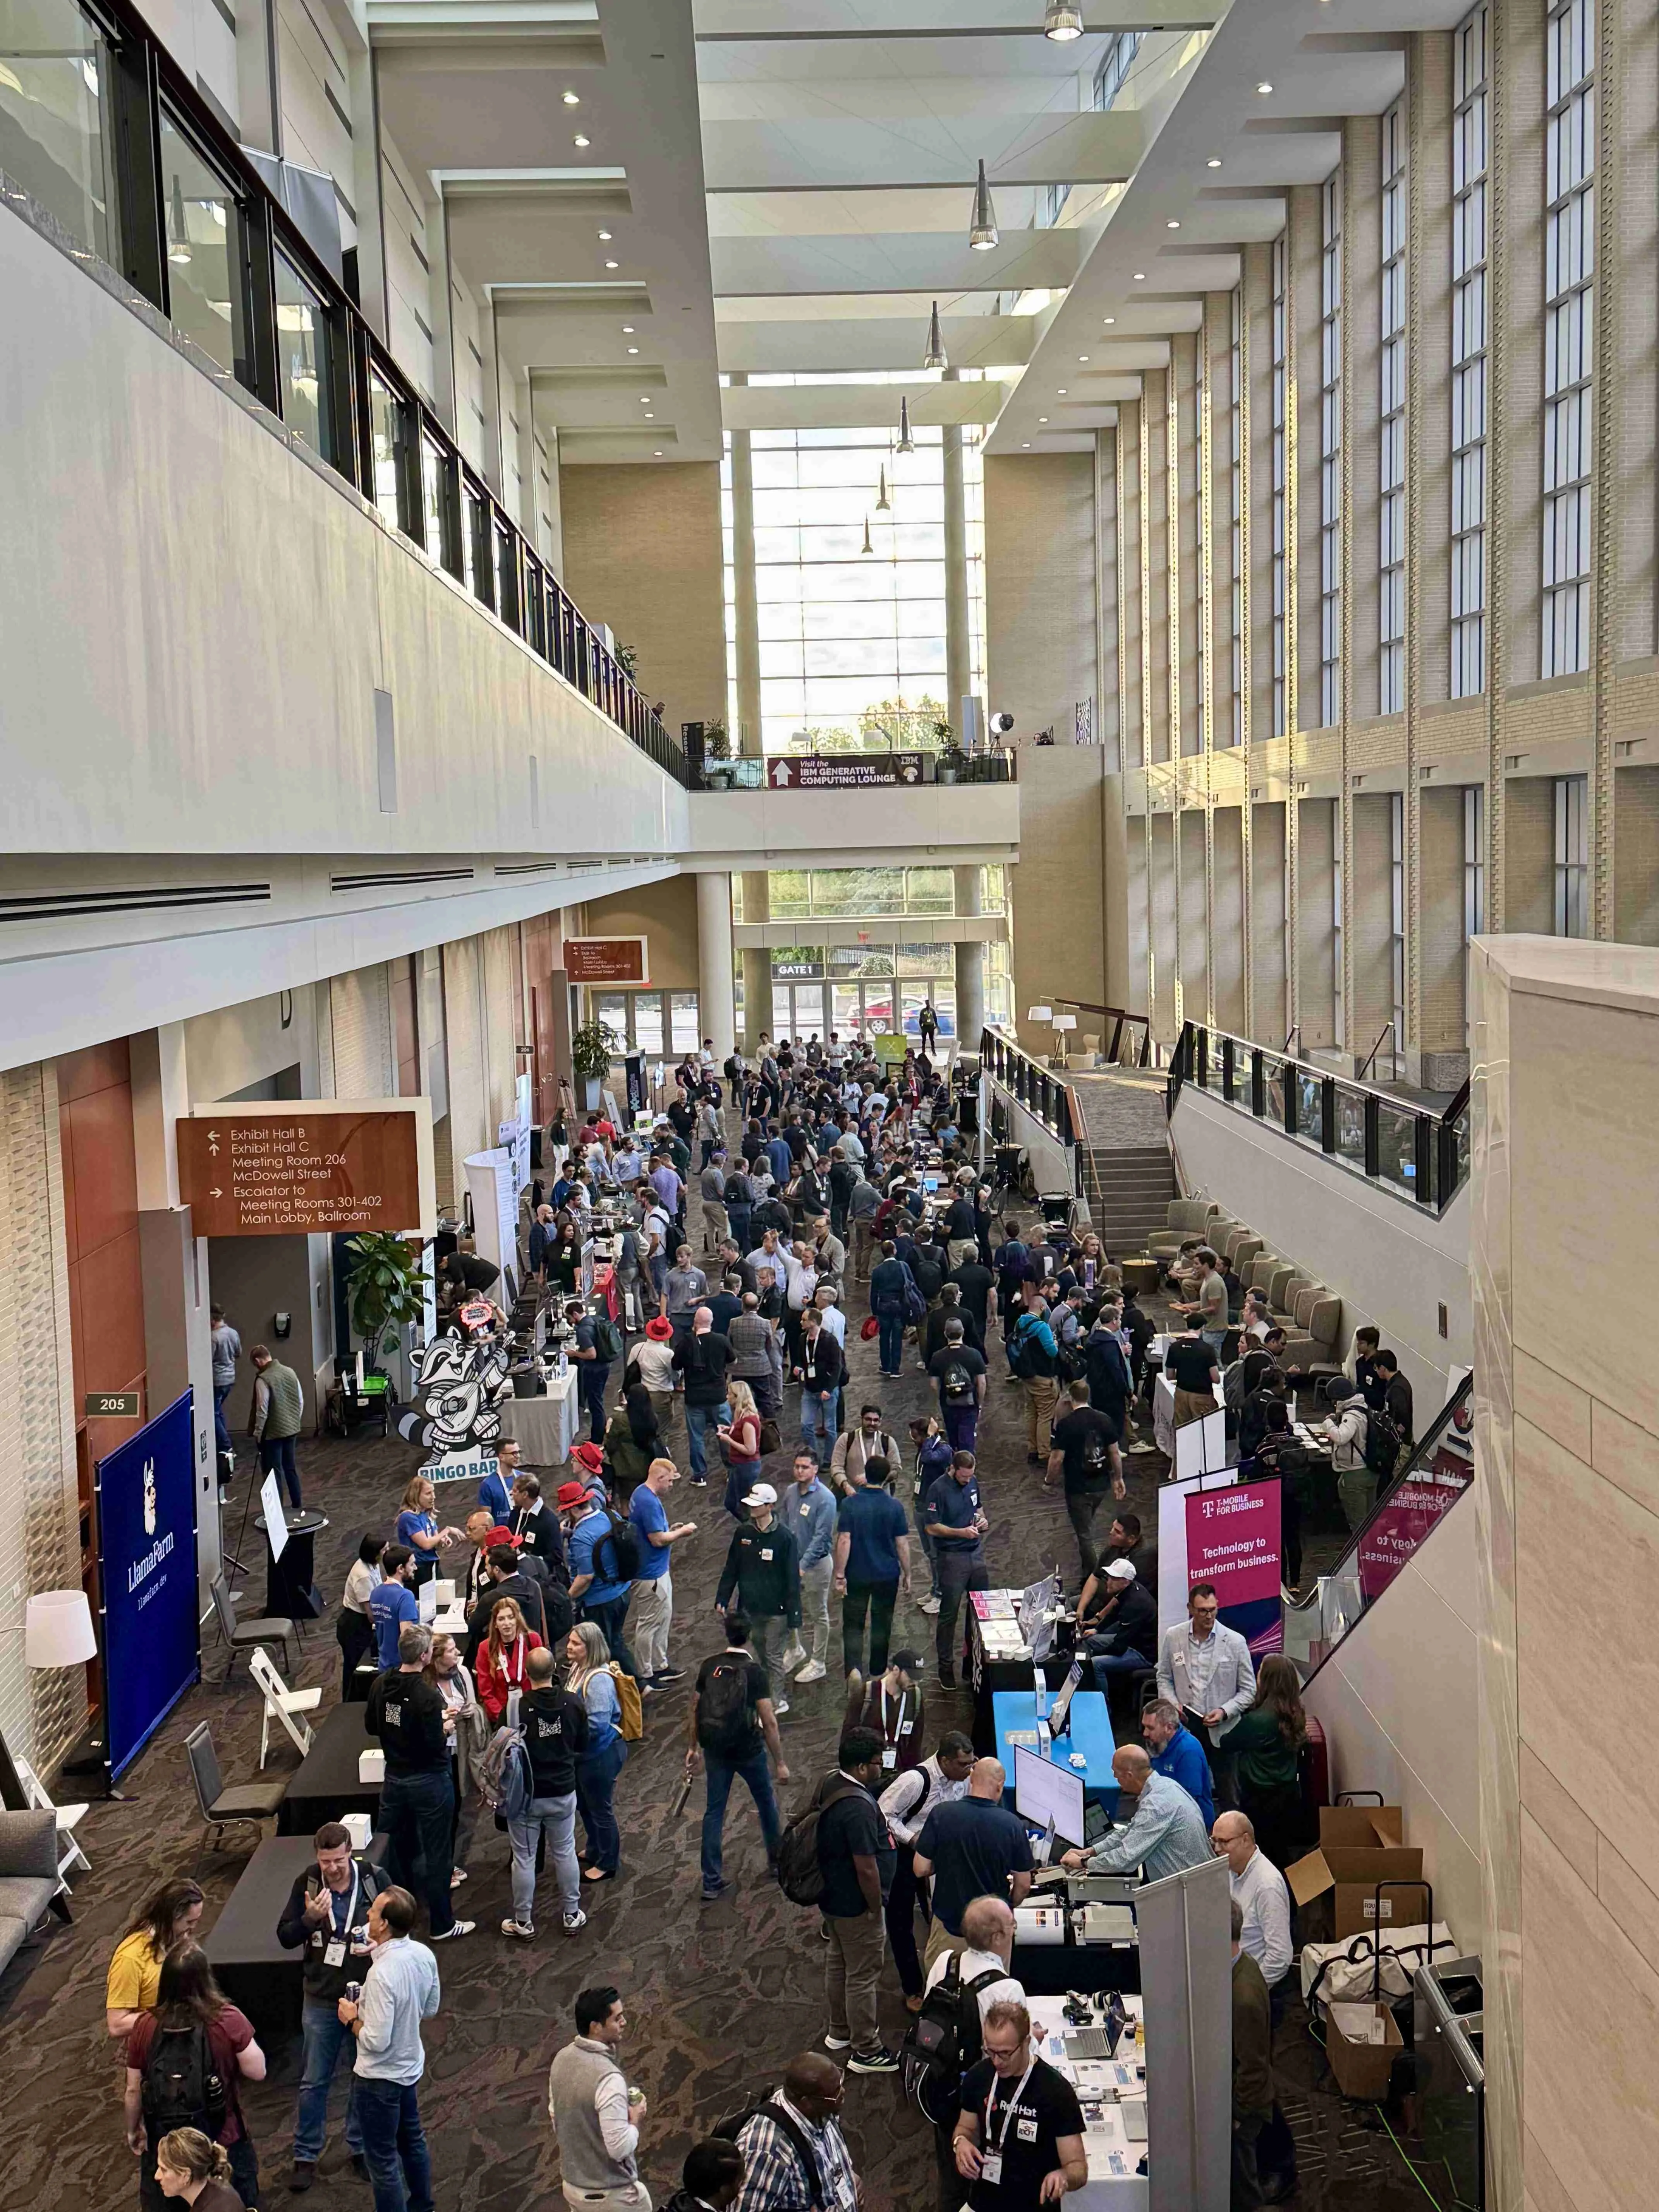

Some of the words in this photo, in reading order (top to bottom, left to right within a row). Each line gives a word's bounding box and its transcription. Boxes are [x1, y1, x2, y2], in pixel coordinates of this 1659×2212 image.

[901, 756, 919, 765] IBM
[800, 768, 817, 776] IBM
[819, 766, 876, 775] GENERATIVE
[800, 775, 856, 785] COMPUTING
[858, 774, 896, 783] LOUNGE
[779, 966, 806, 974] GATE
[808, 966, 812, 974] 1
[230, 1129, 269, 1140] Exhibit
[273, 1128, 294, 1139] Hall
[299, 1128, 305, 1138] B
[232, 1143, 270, 1154] Exhibit
[273, 1142, 295, 1153] Hall
[299, 1141, 309, 1152] C
[232, 1157, 283, 1168] Meeting
[287, 1156, 321, 1166] Room
[325, 1154, 346, 1165] 206
[233, 1169, 294, 1182] McDowell
[297, 1168, 331, 1179] Street
[234, 1186, 290, 1197] Escalator
[293, 1185, 305, 1195] to
[240, 1200, 290, 1211] Meeting
[295, 1198, 334, 1208] Rooms
[337, 1195, 382, 1208] 301-402
[241, 1213, 271, 1224] Main
[318, 1211, 371, 1221] Ballroom
[100, 1399, 124, 1410] 205
[420, 1465, 466, 1481] BINGO
[469, 1460, 498, 1475] BAR
[1216, 1494, 1249, 1508] T-MOBILE
[1216, 1506, 1230, 1516] FOR
[1231, 1499, 1264, 1512] BUSINESS
[1202, 1540, 1255, 1559] Technology
[1256, 1537, 1266, 1547] to
[128, 1532, 174, 1593] LlamaFarm
[1190, 1561, 1235, 1579] transform
[1238, 1554, 1278, 1569] business.
[1018, 2105, 1037, 2117] Hat
